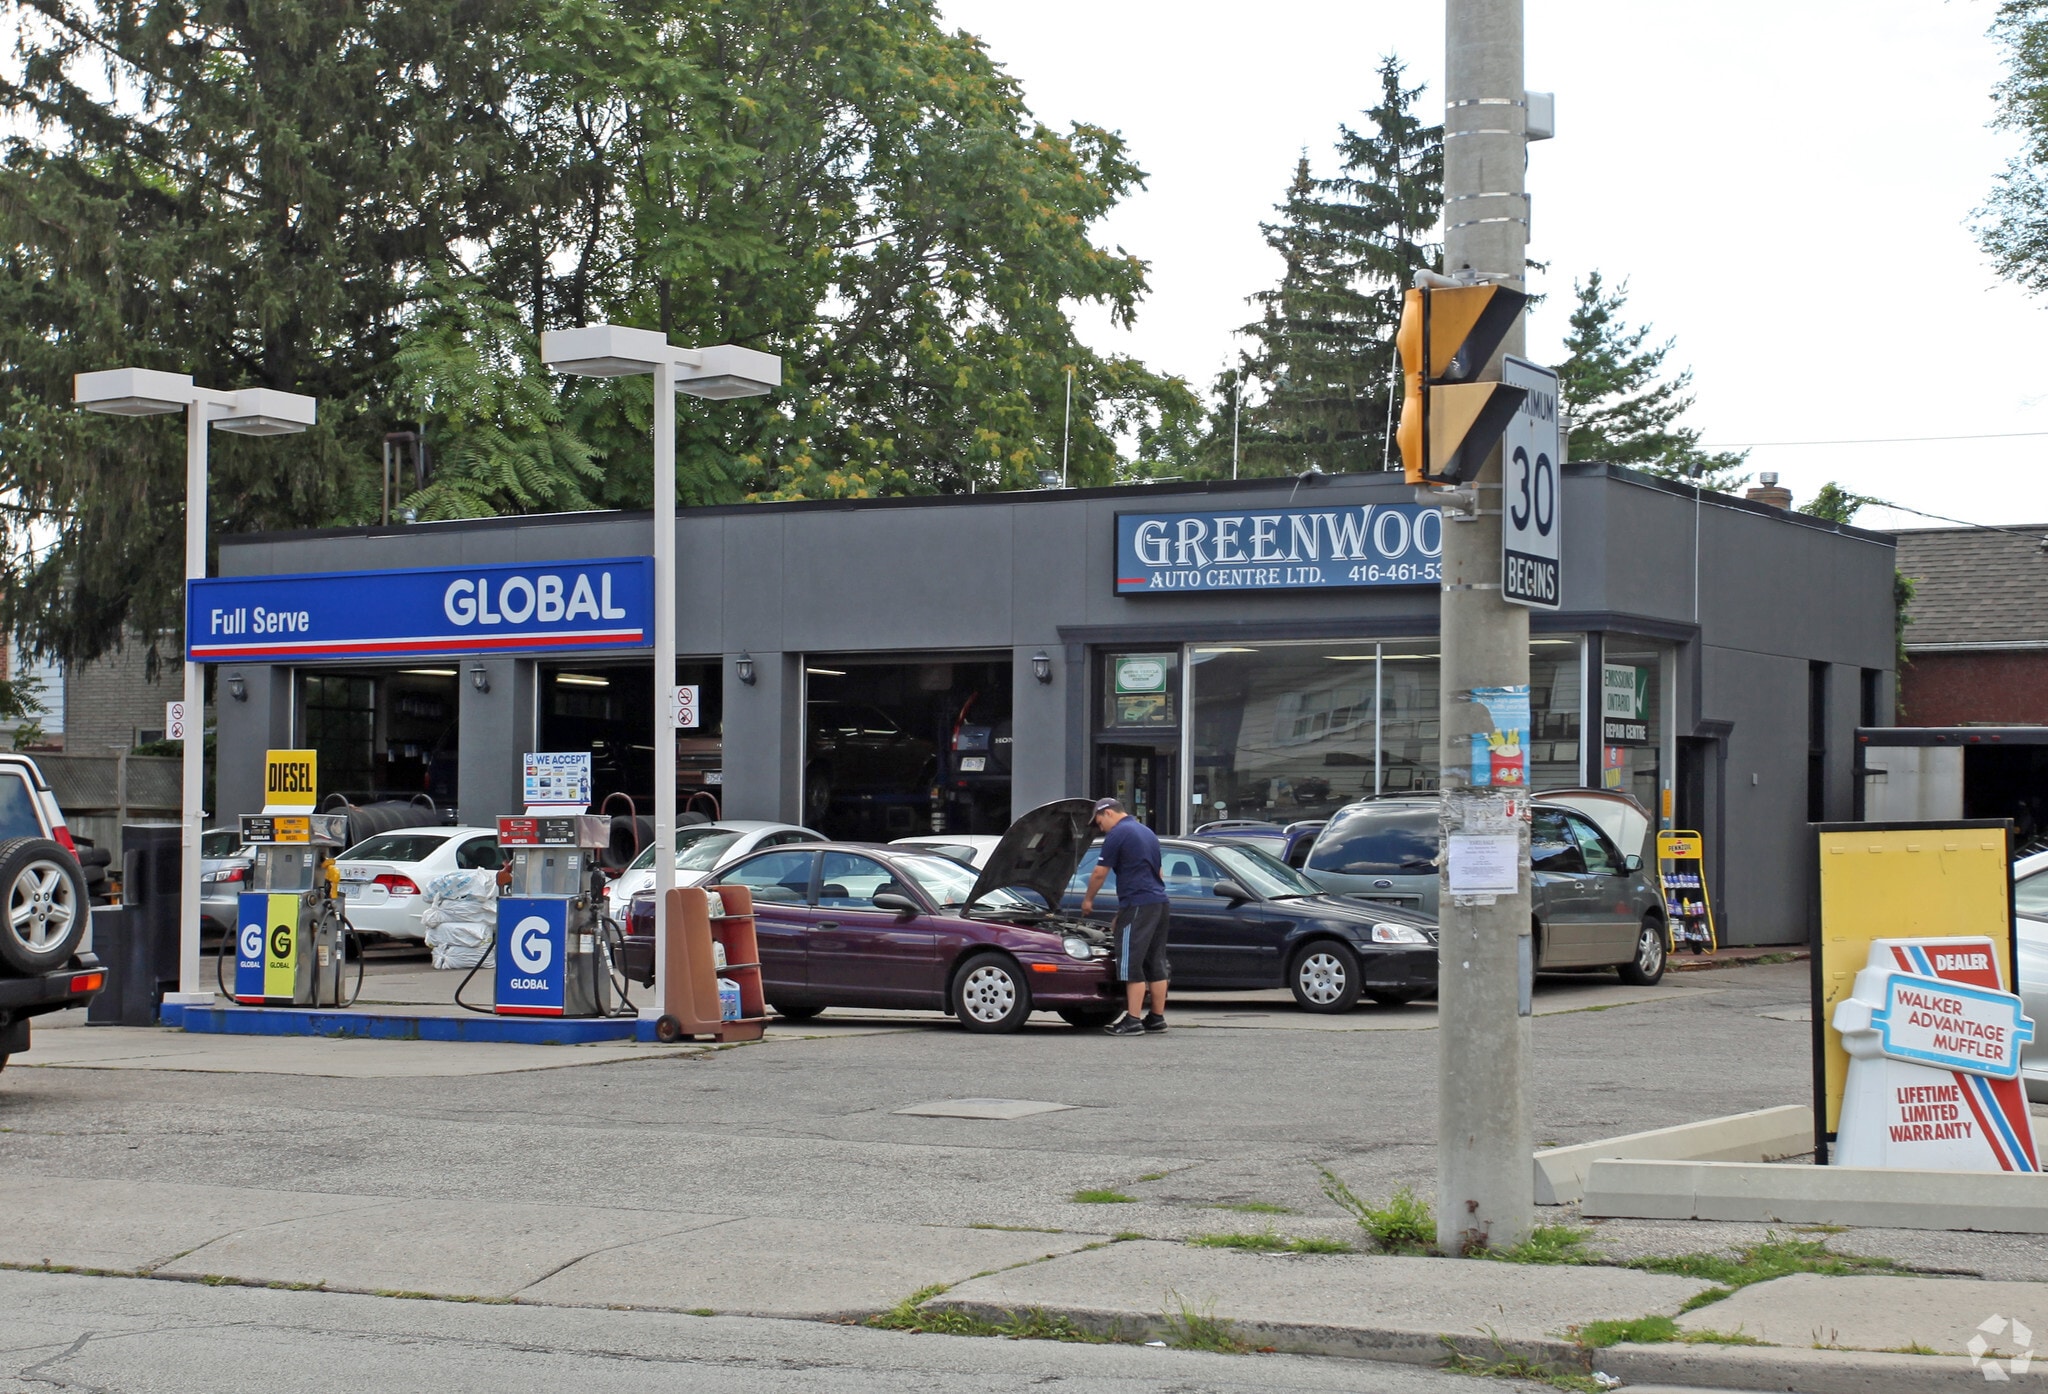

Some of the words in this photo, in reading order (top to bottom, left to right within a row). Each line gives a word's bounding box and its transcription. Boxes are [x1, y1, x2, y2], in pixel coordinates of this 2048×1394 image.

[1509, 381, 1554, 423] XIMUM
[1510, 445, 1554, 537] 30
[1150, 569, 1201, 588] AUTO
[1206, 567, 1281, 587] CENTRE
[1285, 566, 1326, 584] LTD.
[1508, 556, 1555, 601] BEGINS
[443, 572, 626, 627] GLOBAL
[211, 607, 247, 636] Full
[253, 606, 310, 633] Serve
[1604, 669, 1634, 690] EMISSIONS
[1607, 692, 1631, 712] ONTARIO
[1605, 723, 1625, 739] REPAIR
[1626, 724, 1646, 740] CENTRE
[536, 755, 550, 765] WE
[552, 754, 587, 765] ACCEPT
[268, 762, 313, 793] DIESEL
[1668, 843, 1692, 852] PENNZOIL
[240, 960, 261, 968] GLOBAL
[270, 961, 290, 969] GLOBAL
[1935, 953, 1989, 972] DEALER
[510, 978, 549, 991] GLOBAL
[1897, 989, 1963, 1016] WALKER
[1908, 1011, 2005, 1043] ADVANTAGE
[1933, 1033, 2004, 1061] MUFFLER
[1896, 1084, 1960, 1105] LIFETIME
[1901, 1103, 1959, 1124] LIMITED
[1889, 1121, 1973, 1143] WARRANTY
